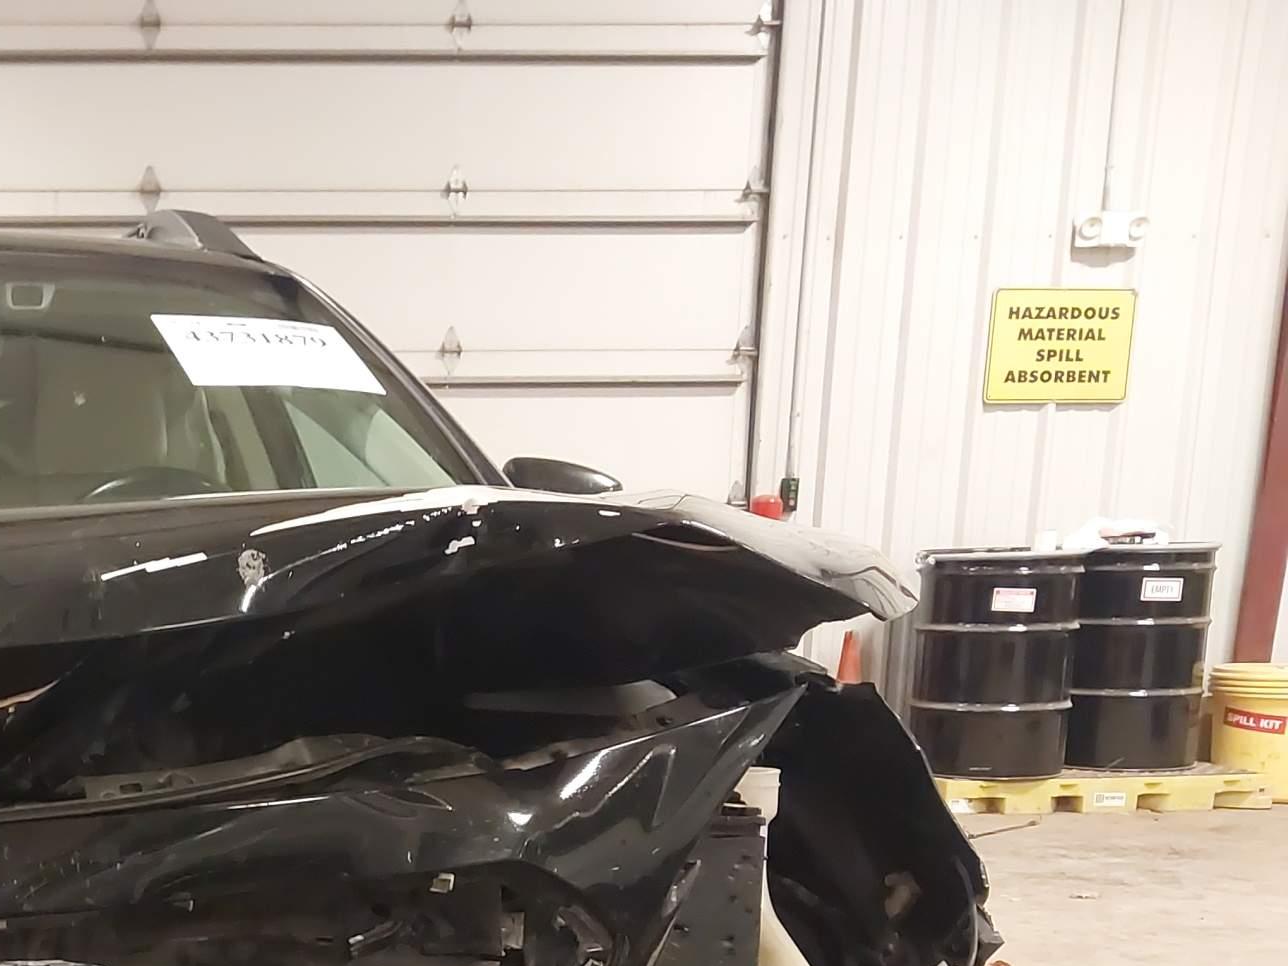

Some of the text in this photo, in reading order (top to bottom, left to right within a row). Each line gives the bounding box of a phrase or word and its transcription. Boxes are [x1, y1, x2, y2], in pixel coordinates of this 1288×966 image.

[1008, 306, 1121, 320] HAZARDOUS
[1017, 328, 1106, 341] MATERIAL
[1035, 349, 1084, 362] SPILL
[1004, 370, 1111, 383] ABSORBENT
[1227, 712, 1283, 730] SPILL KIT
